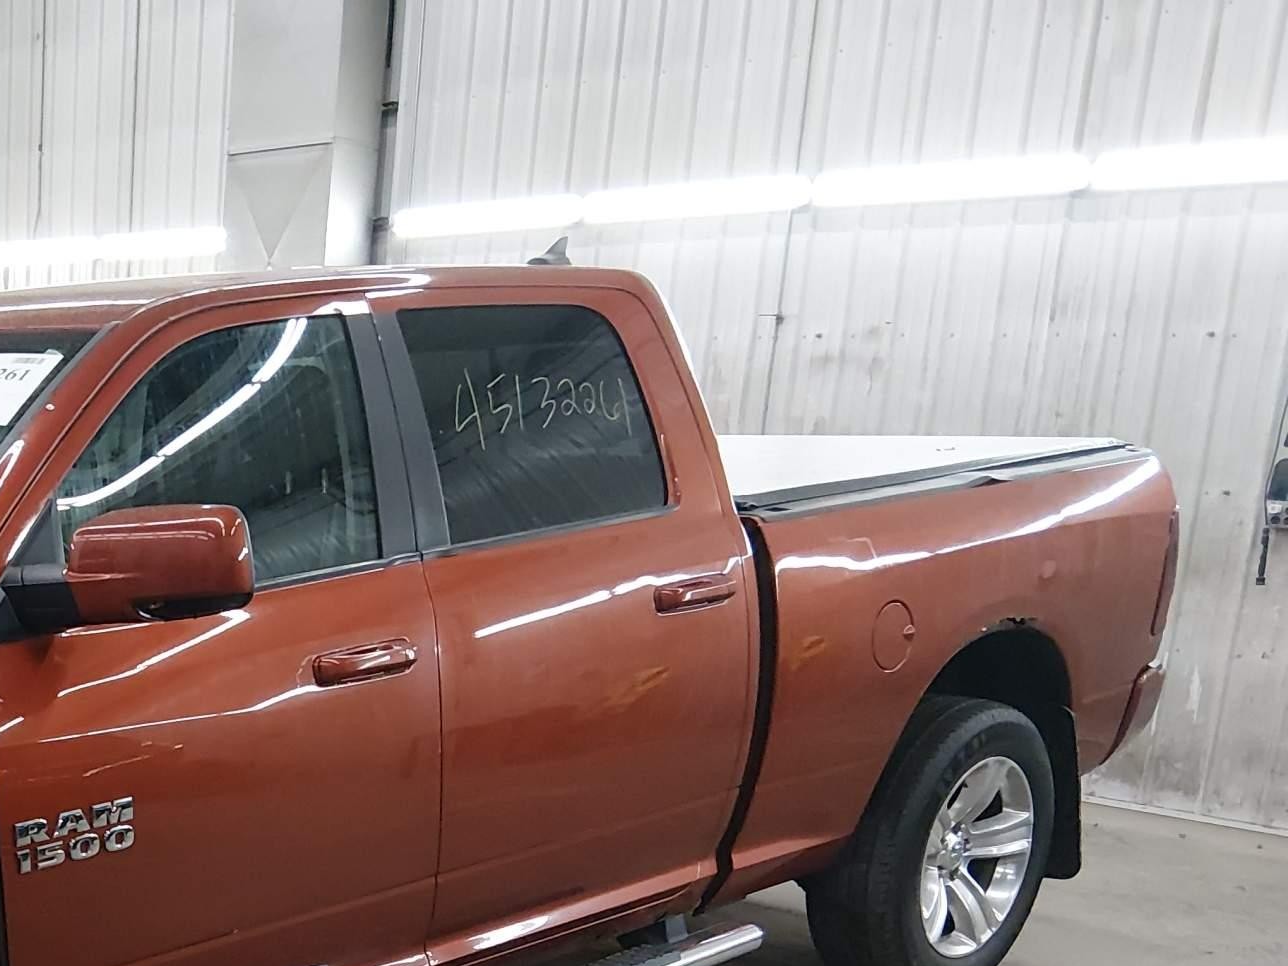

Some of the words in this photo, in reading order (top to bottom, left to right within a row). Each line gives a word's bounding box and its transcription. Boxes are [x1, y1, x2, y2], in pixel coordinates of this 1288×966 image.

[454, 367, 632, 451] 45132261
[14, 796, 134, 847] RAM
[16, 824, 136, 875] 1500
